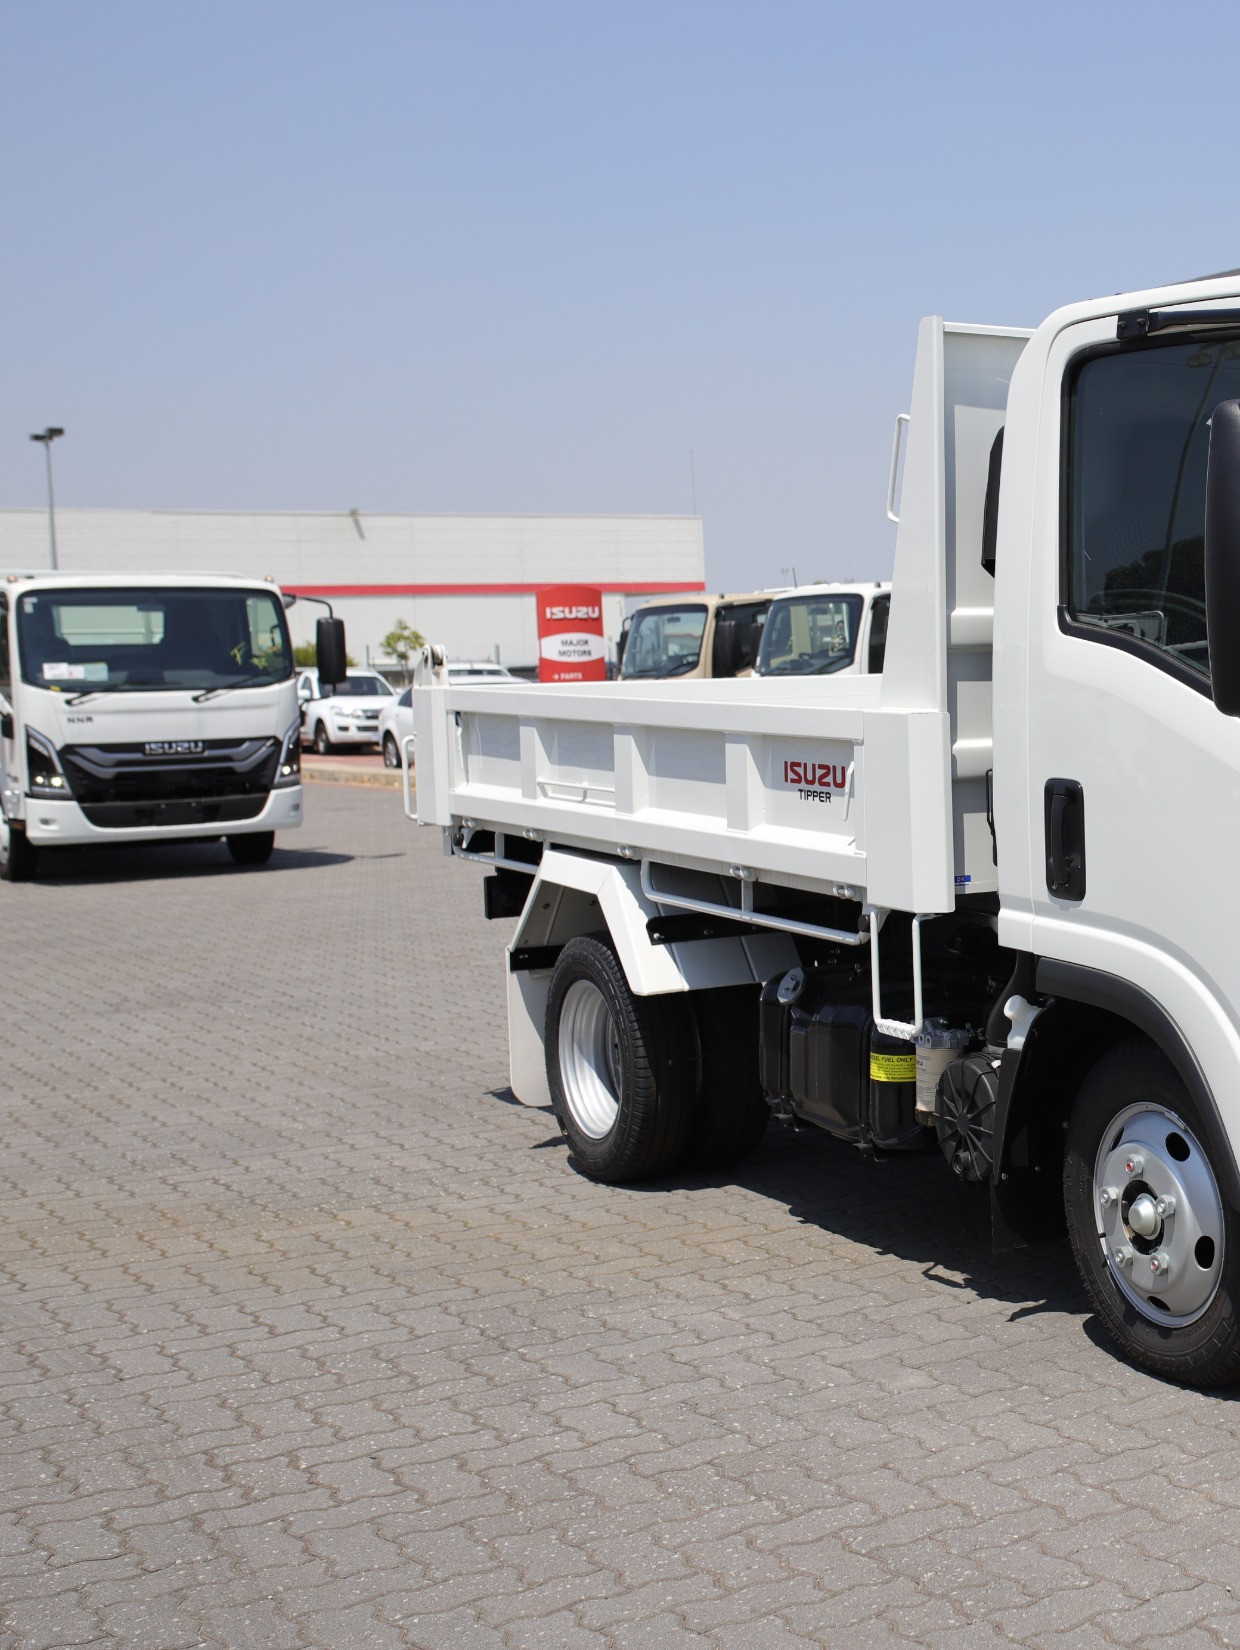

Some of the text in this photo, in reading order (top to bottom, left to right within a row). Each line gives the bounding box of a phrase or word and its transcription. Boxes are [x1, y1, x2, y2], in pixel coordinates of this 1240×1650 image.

[545, 606, 600, 620] ISUZU
[561, 639, 589, 647] MAJOR
[560, 672, 583, 680] PARTS
[144, 740, 203, 755] ISUZU
[783, 760, 847, 789] ISUZU
[797, 788, 832, 804] TIPPER
